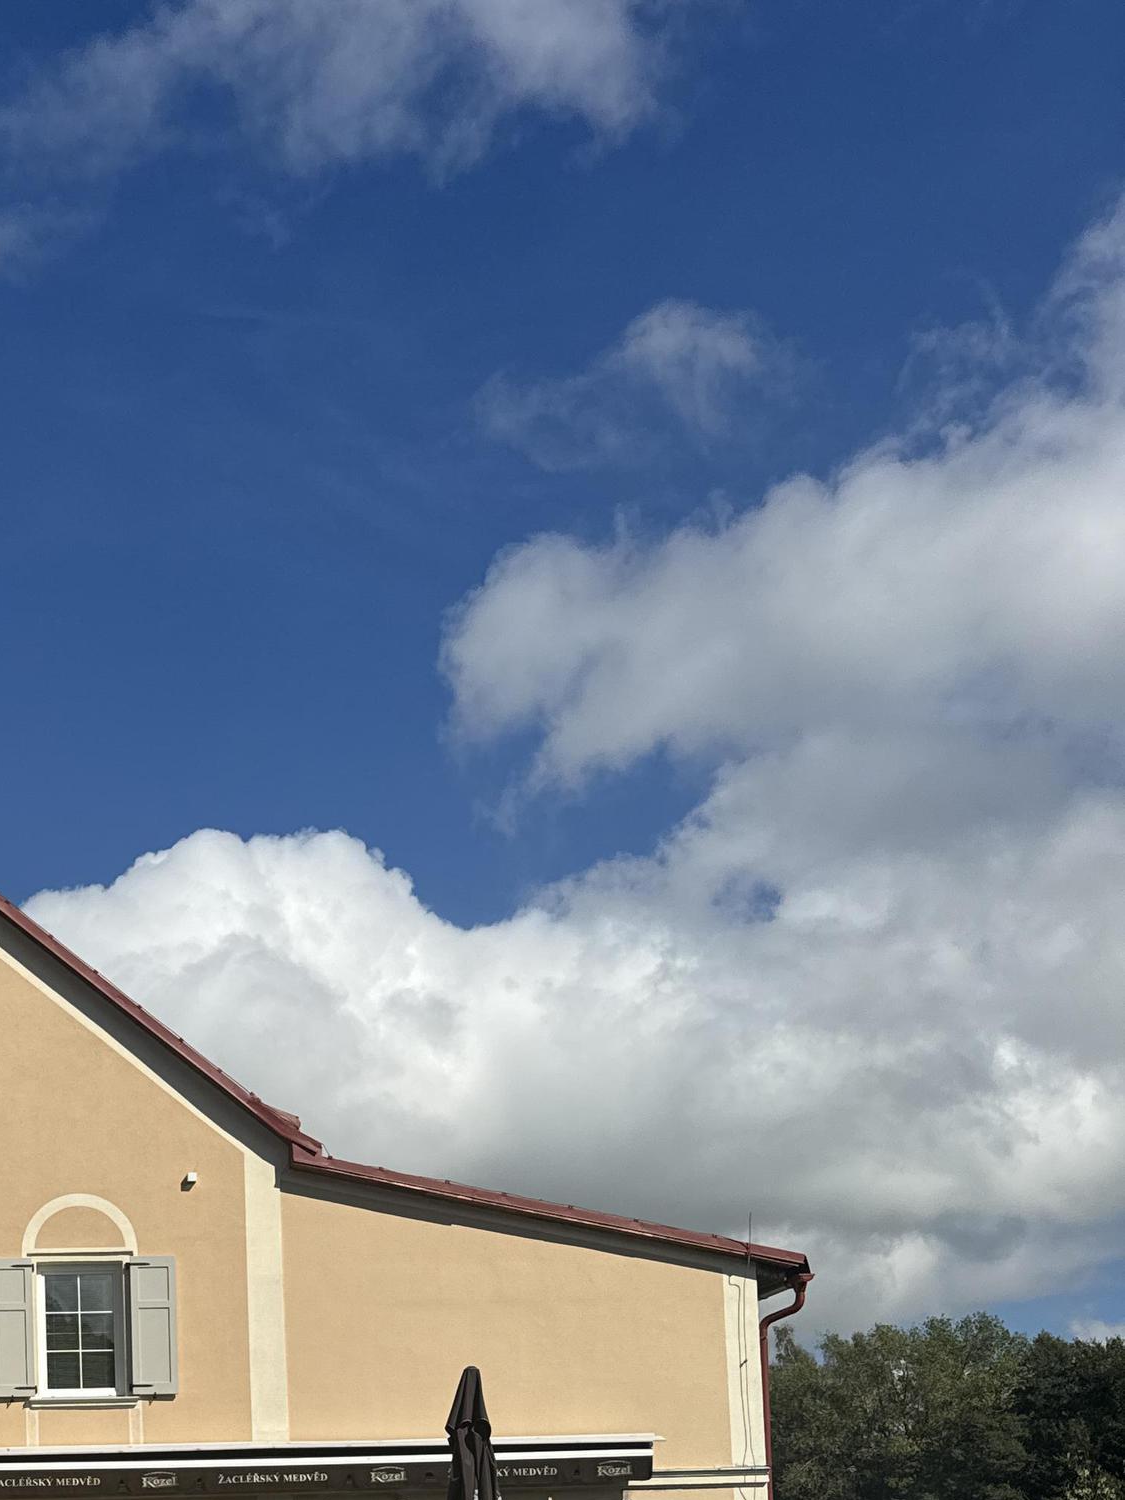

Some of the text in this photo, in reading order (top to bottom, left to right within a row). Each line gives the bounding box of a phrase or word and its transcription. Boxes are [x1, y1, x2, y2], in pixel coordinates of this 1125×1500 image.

[512, 1465, 558, 1476] MEDVĚD
[597, 1465, 632, 1477] Kozel
[55, 1475, 101, 1486] MEDVĚD
[141, 1475, 178, 1488] Kozel
[218, 1471, 328, 1484] ŽACLÉŘSKÝ MEDVĚD
[370, 1471, 406, 1483] Kozel
